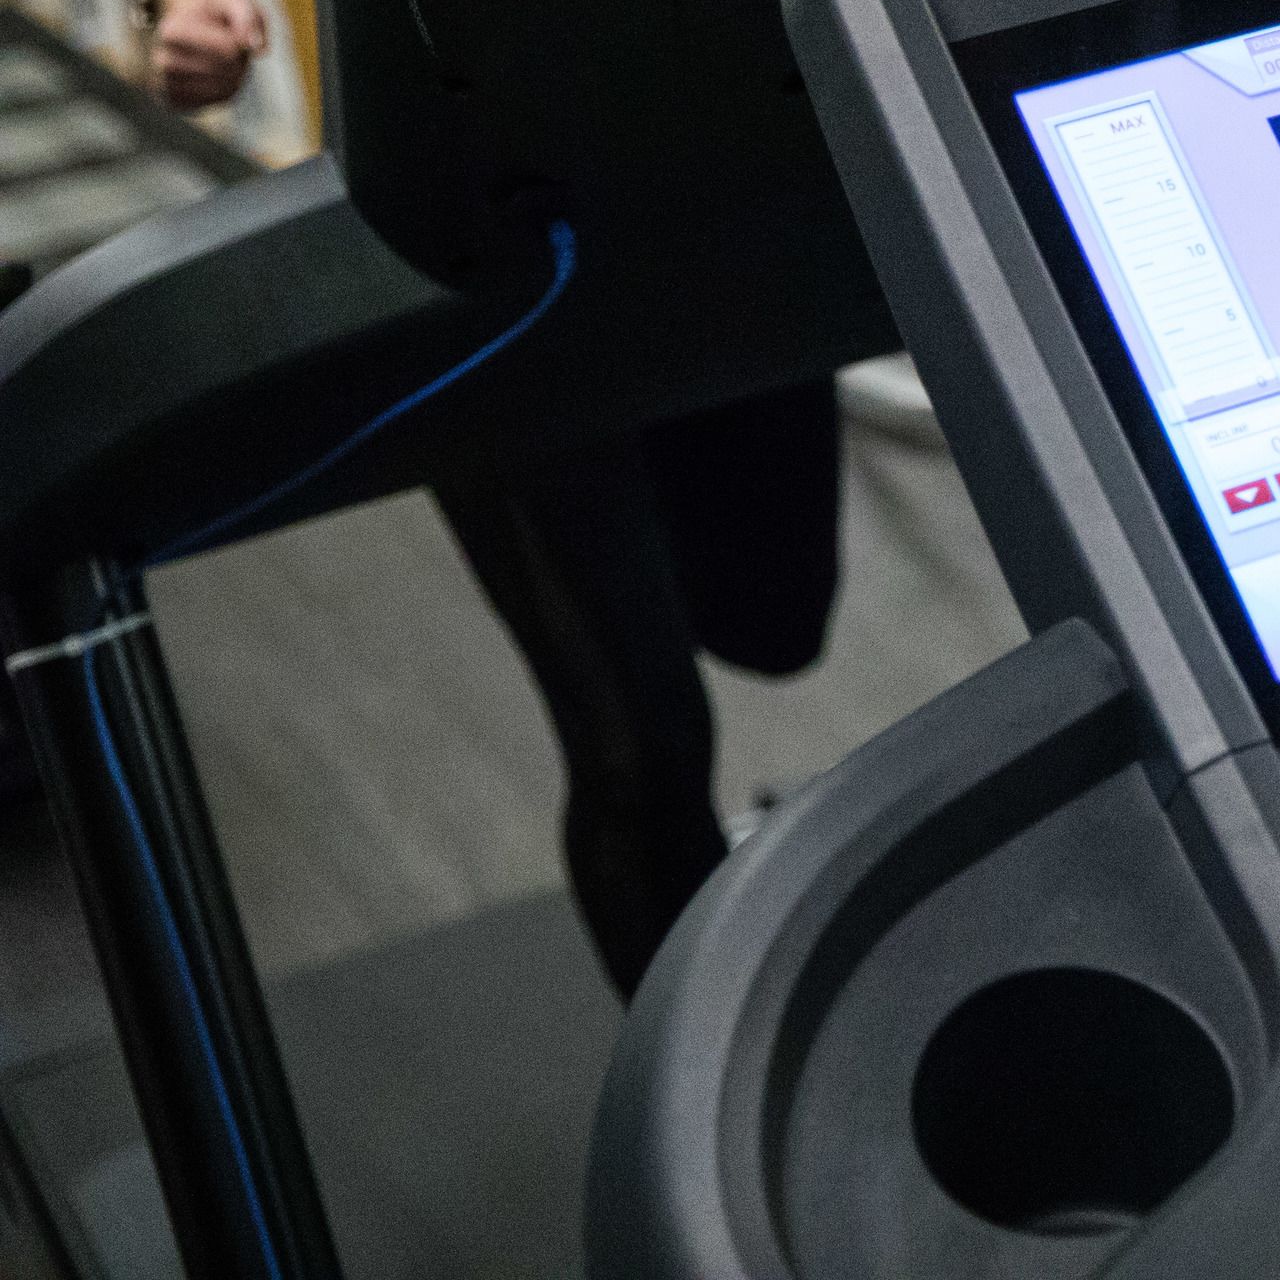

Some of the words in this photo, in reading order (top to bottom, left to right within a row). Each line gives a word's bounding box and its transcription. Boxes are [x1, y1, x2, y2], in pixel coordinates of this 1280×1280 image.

[1109, 115, 1146, 134] MAX
[1156, 178, 1177, 194] 15
[1186, 243, 1207, 258] 10
[1225, 308, 1237, 322] 5
